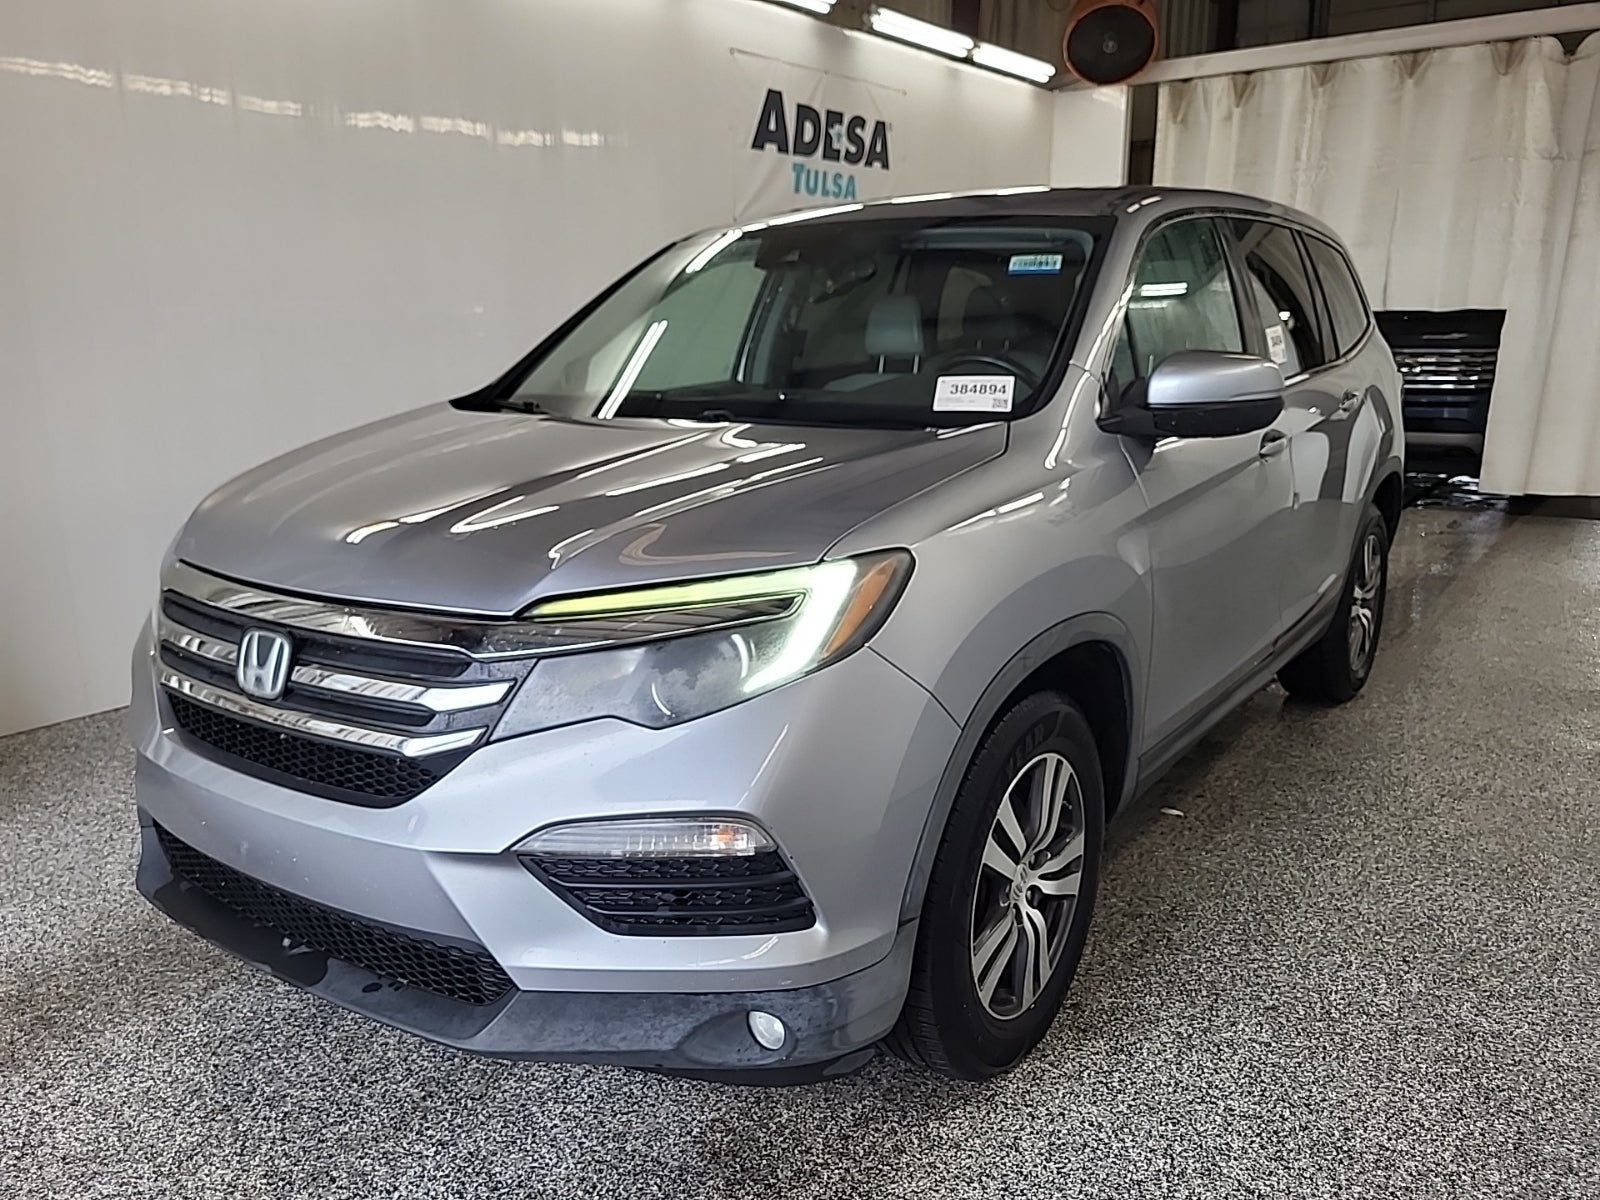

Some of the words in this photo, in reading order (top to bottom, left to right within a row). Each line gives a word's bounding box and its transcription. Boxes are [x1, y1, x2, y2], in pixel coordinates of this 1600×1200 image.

[751, 88, 890, 170] ADESA
[792, 163, 856, 200] TULSA
[949, 383, 1007, 395] 384894
